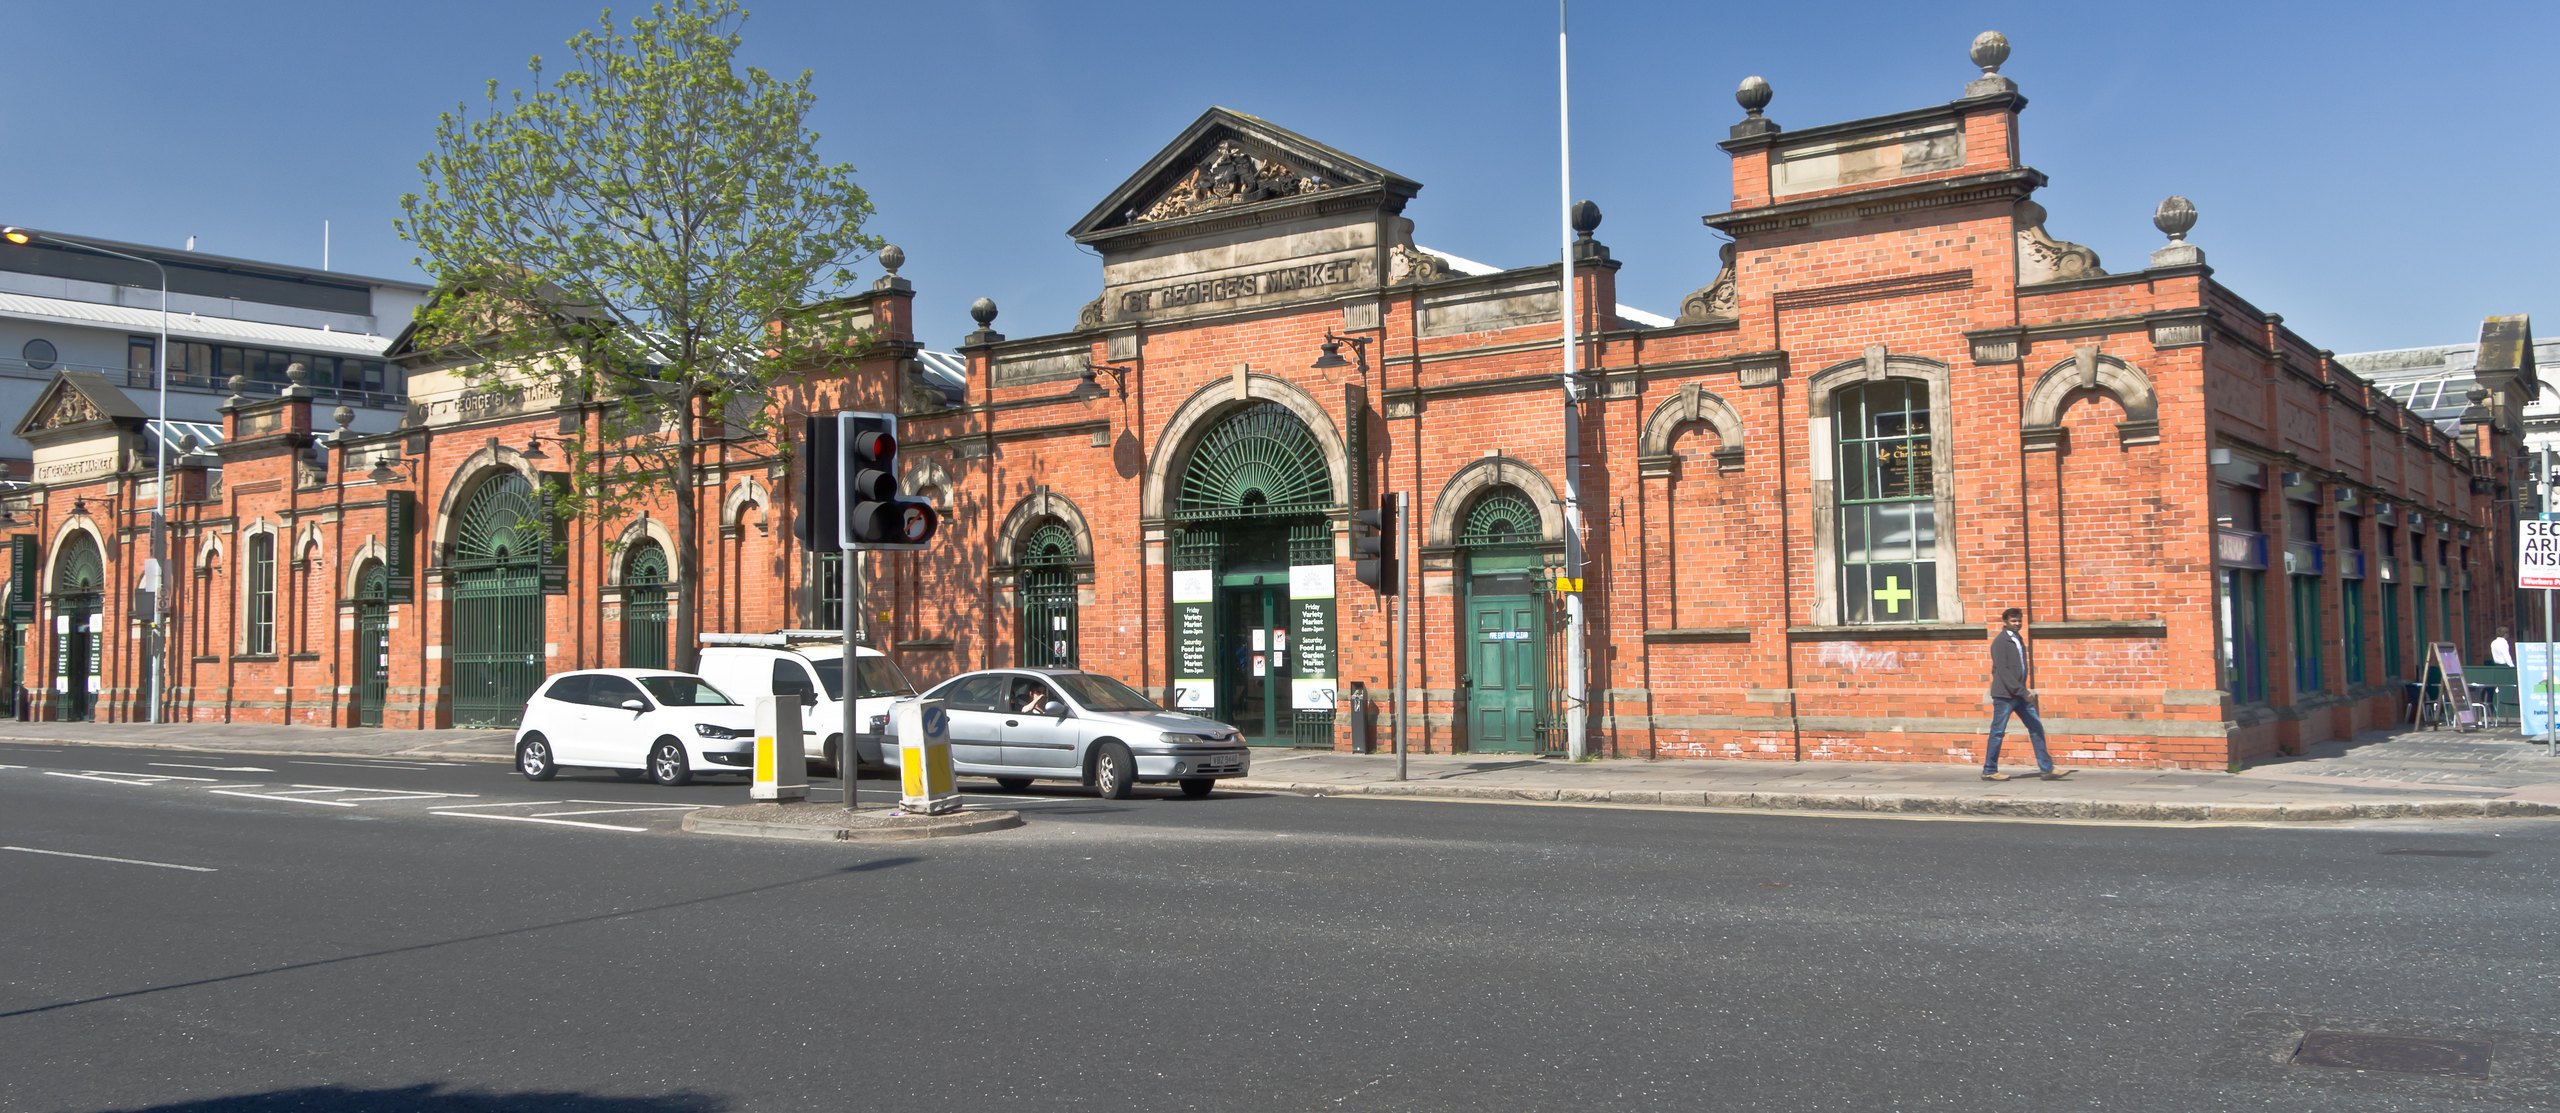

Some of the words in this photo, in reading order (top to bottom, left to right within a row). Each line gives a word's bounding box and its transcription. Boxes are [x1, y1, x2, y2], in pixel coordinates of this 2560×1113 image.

[1130, 290, 1152, 312] ST
[1161, 275, 1257, 308] GEORGE'S
[1266, 259, 1354, 293] MARKET
[454, 392, 503, 413] GEORGE'S
[1350, 399, 1358, 444] MARKET
[1351, 446, 1359, 502] GEORGE'S
[390, 498, 400, 528] MARKET
[14, 541, 24, 564] MARKET
[390, 530, 400, 566] GEORGE'S
[543, 555, 553, 564] ST
[13, 565, 24, 594] GEORGE'S
[391, 568, 400, 576] ST
[2523, 577, 2553, 585] Workers
[13, 594, 23, 602] ST
[1302, 610, 1324, 619] Variety
[1305, 603, 1320, 611] Friday
[1184, 614, 1203, 622] Variety
[1315, 643, 1327, 651] and
